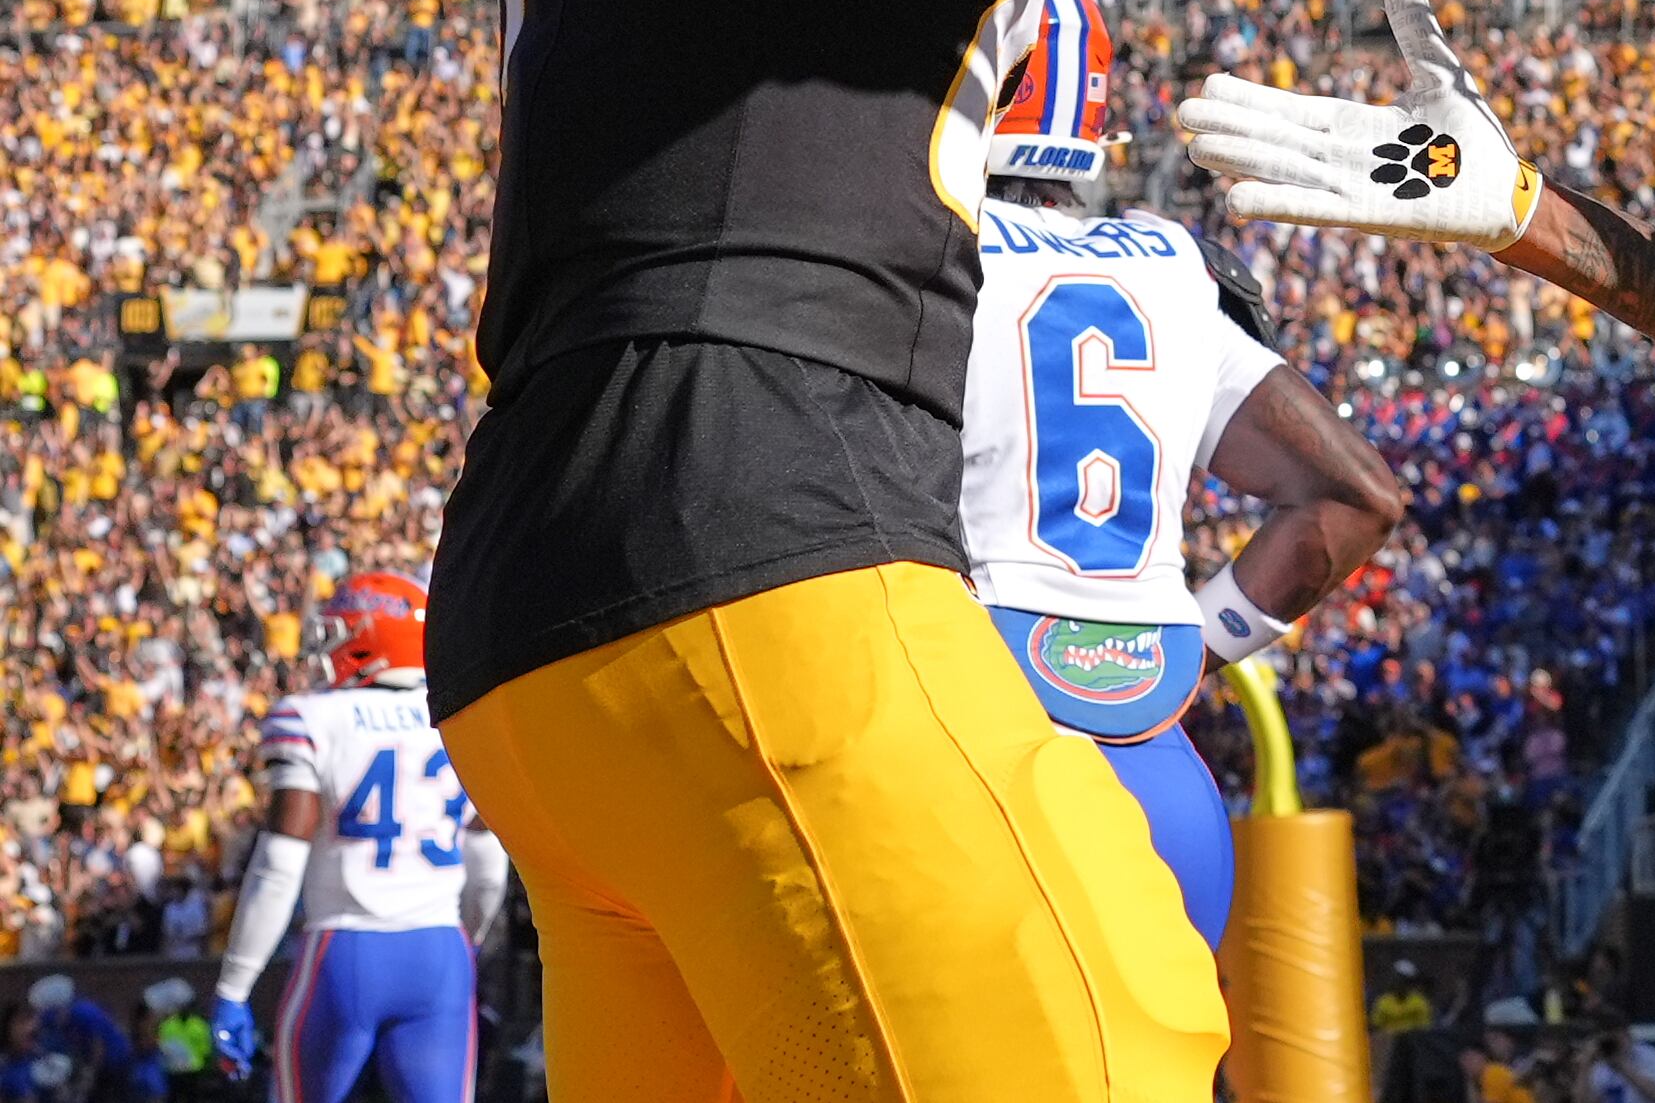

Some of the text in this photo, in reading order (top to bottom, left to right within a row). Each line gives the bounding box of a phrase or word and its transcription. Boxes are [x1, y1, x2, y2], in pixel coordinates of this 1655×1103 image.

[1018, 273, 1162, 579] 6
[354, 705, 425, 731] ALLEN
[336, 746, 470, 869] 43
